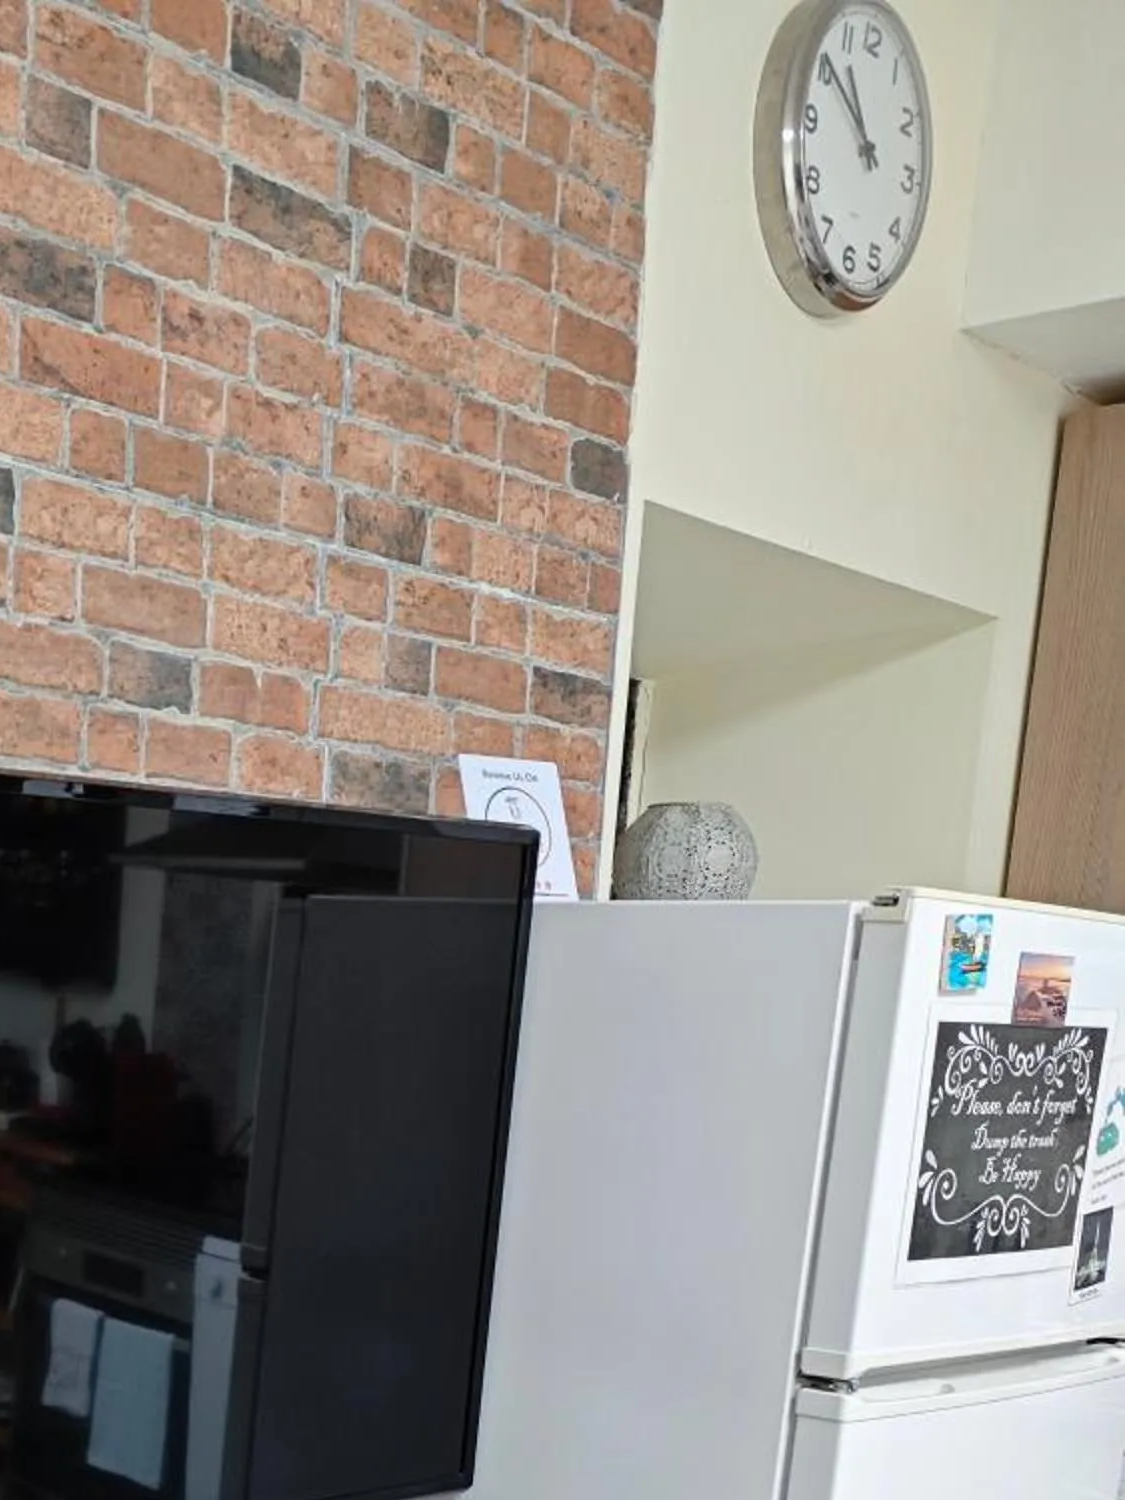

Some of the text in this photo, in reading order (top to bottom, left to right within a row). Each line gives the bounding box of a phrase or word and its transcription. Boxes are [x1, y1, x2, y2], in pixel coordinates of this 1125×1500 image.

[840, 21, 882, 58] 11 12
[805, 104, 818, 134] 9
[899, 107, 914, 137] 2
[806, 166, 820, 194] 8
[900, 164, 915, 194] 3
[821, 215, 834, 244] 7
[888, 217, 901, 244] 4
[842, 246, 856, 273] 6
[866, 243, 881, 272] 5
[1010, 1129, 1027, 1148] the
[1002, 1153, 1042, 1192] Happy
